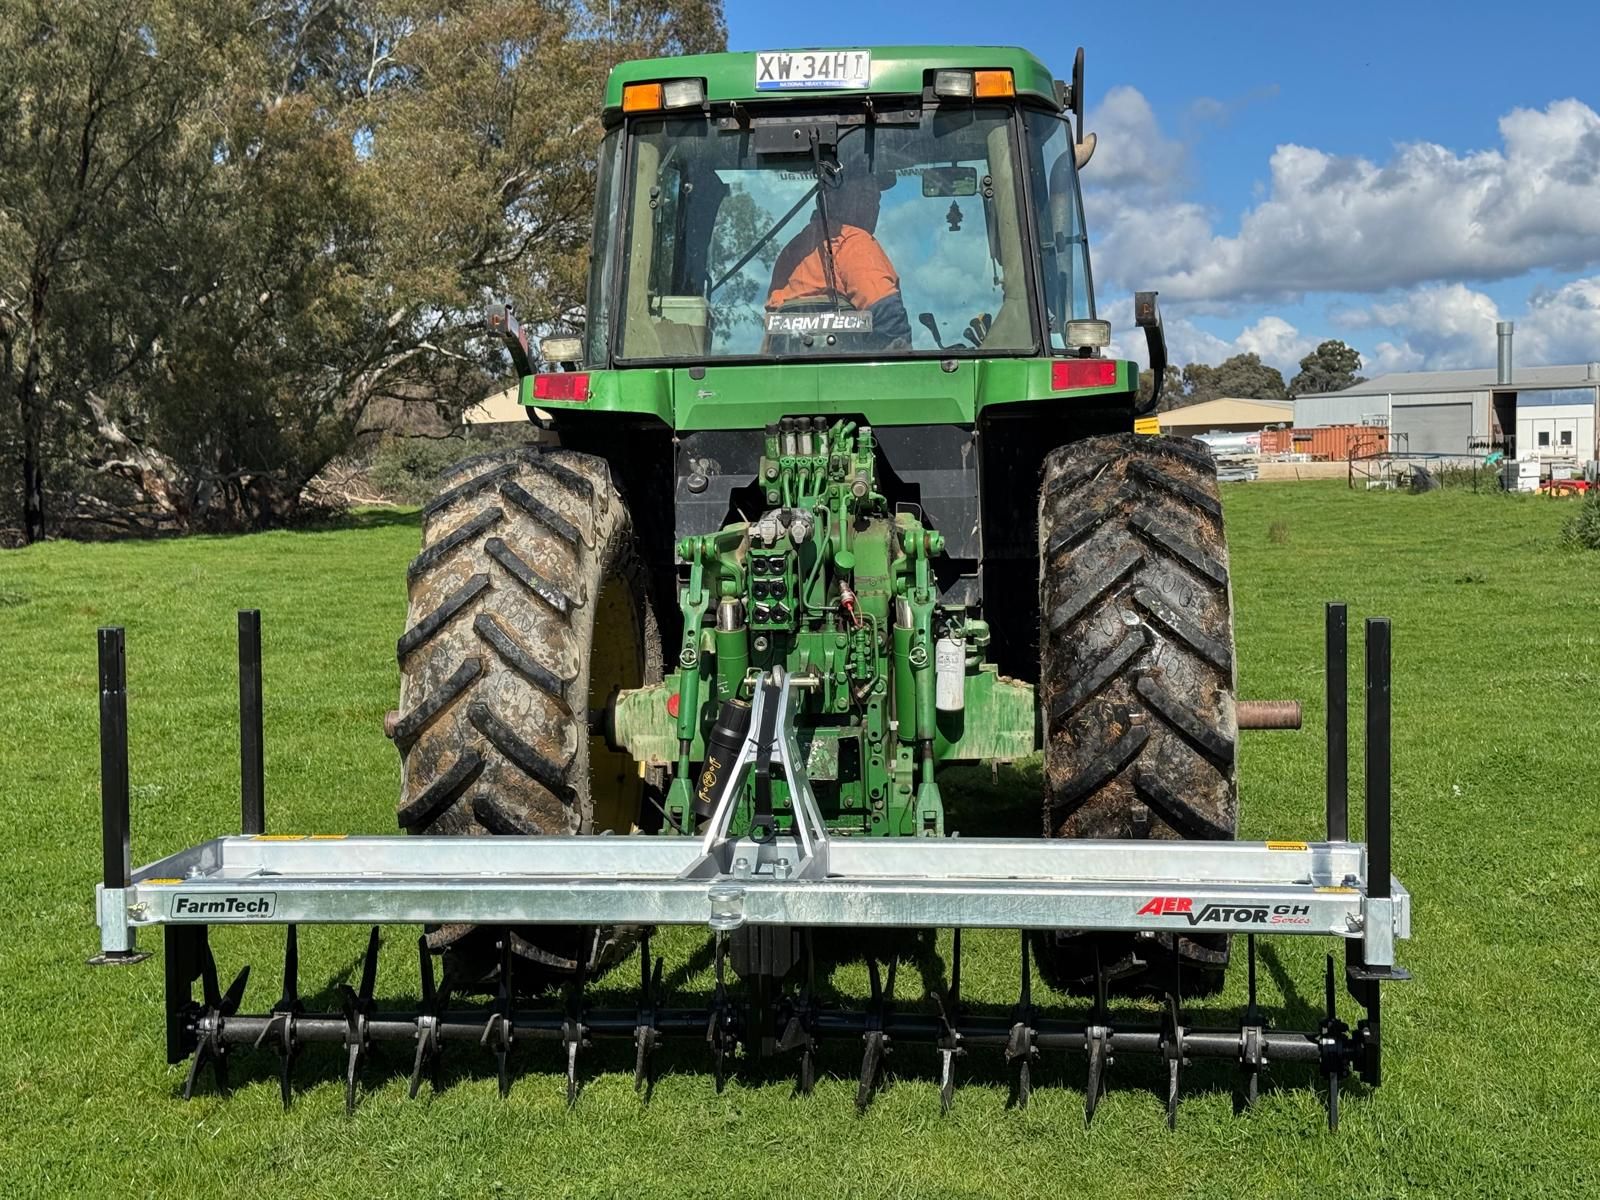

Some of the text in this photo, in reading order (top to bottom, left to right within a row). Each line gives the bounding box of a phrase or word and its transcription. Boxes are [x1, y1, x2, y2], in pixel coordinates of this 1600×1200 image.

[176, 898, 269, 913] FarmTech
[1273, 905, 1310, 915] GH
[1270, 915, 1311, 924] Series
